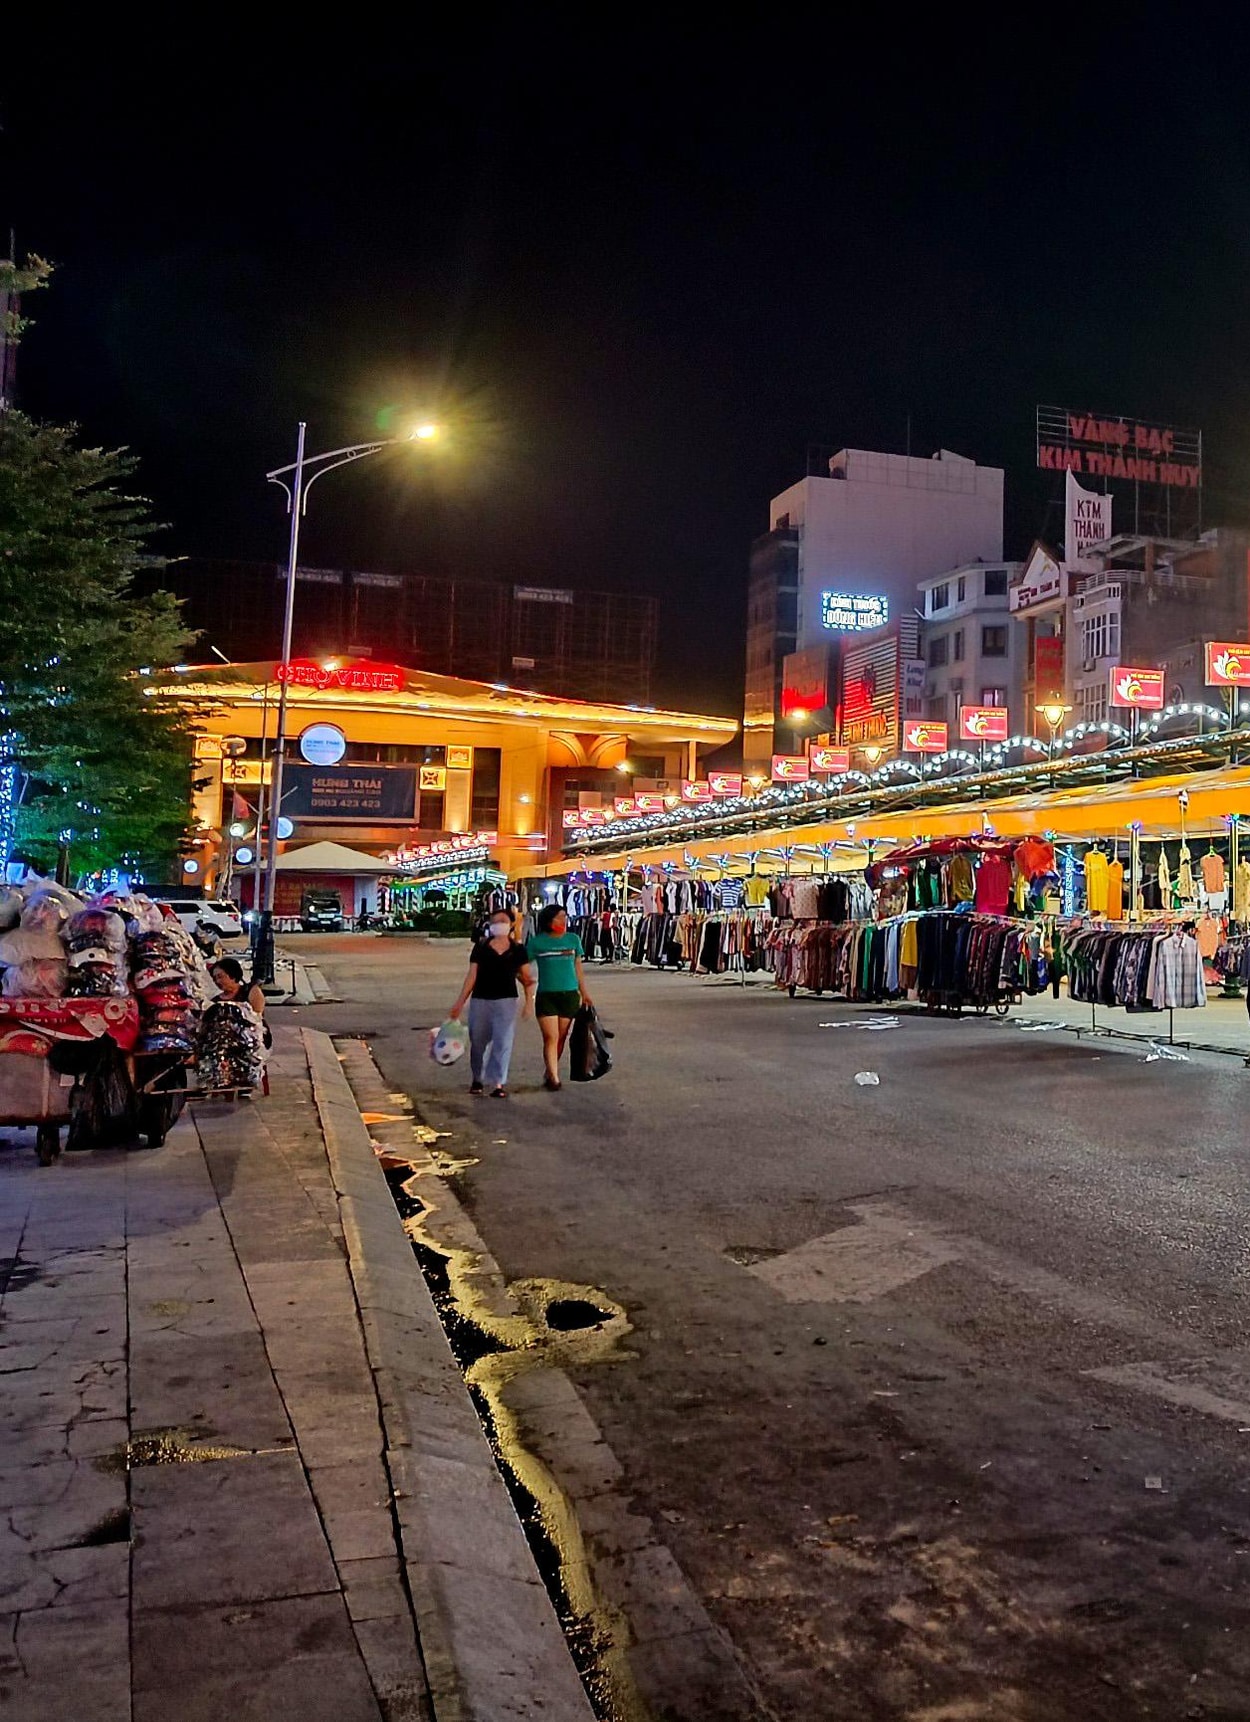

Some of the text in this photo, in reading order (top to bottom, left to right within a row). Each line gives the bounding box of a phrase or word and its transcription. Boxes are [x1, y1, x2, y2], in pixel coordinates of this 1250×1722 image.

[1069, 412, 1175, 455] VÀNG BẠC
[1039, 445, 1081, 472] KIM
[1087, 449, 1156, 482] THÀNH
[1077, 499, 1102, 519] KIM
[336, 669, 399, 690] VINH
[311, 798, 381, 808] 0903 423 423
